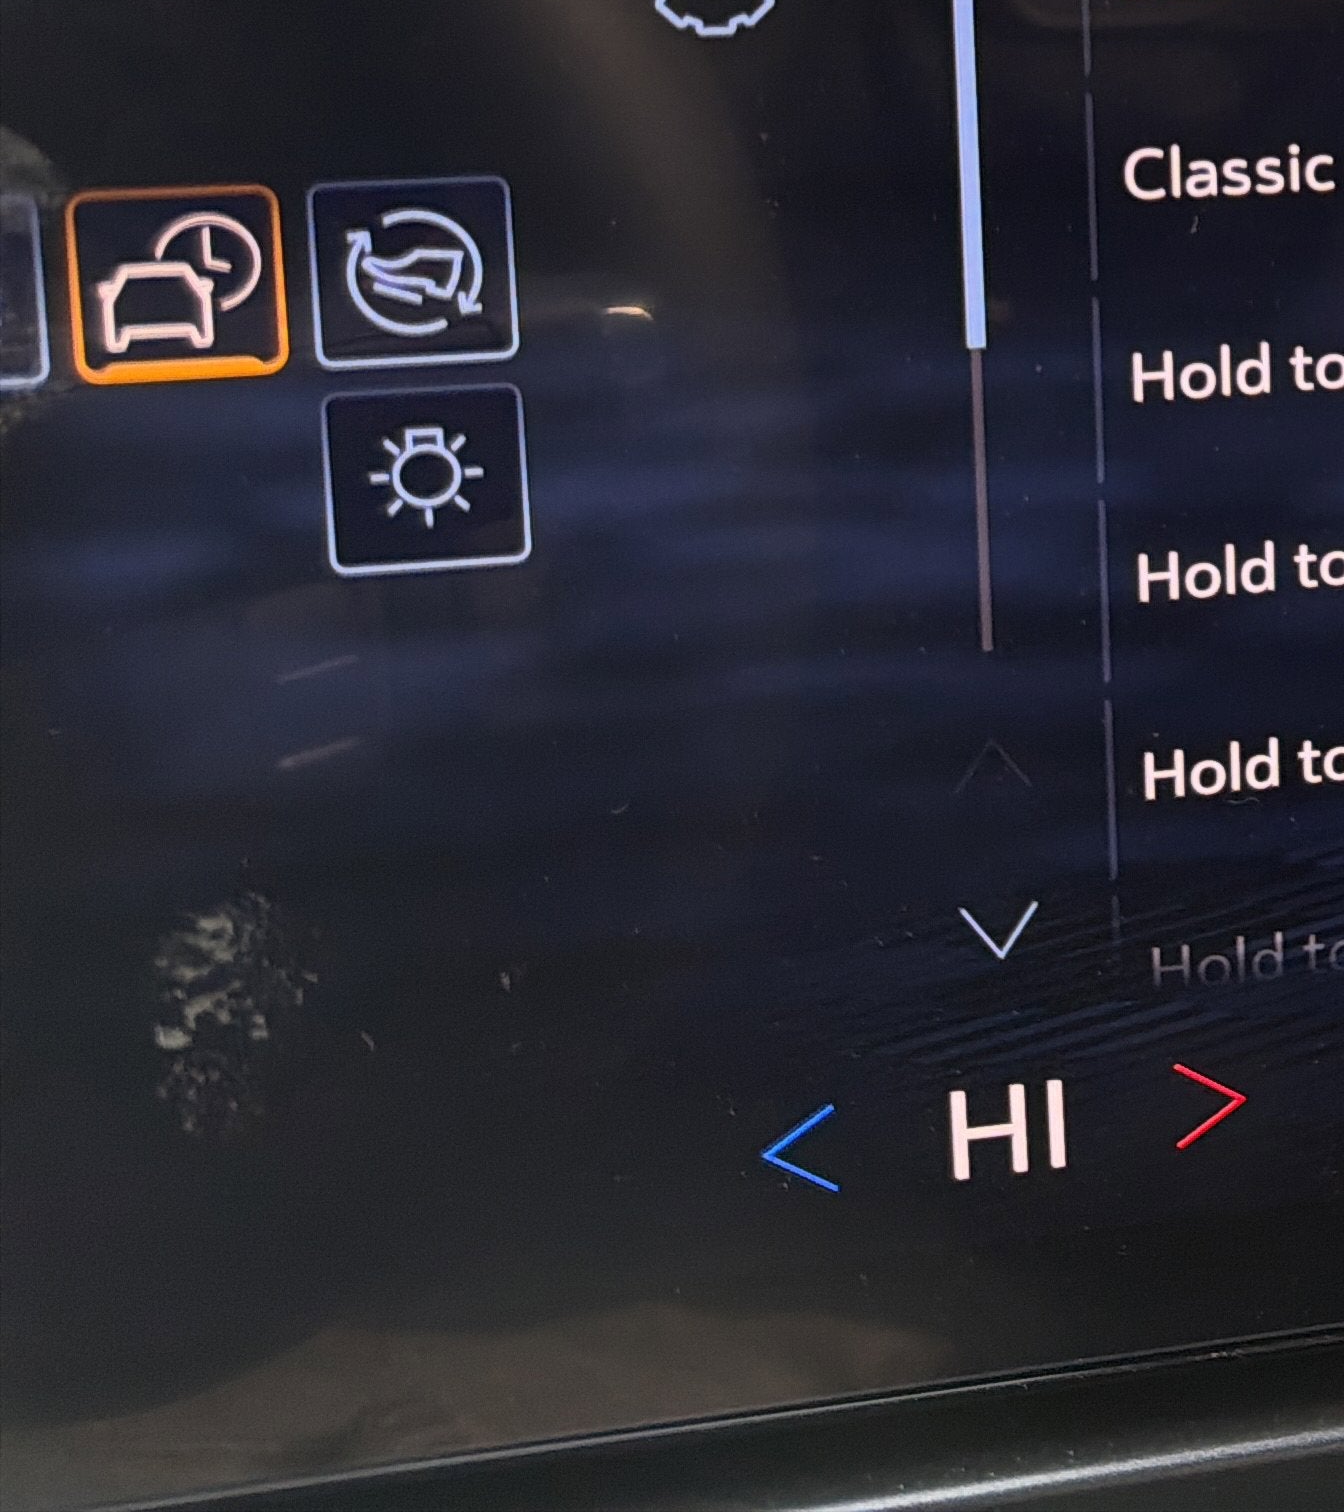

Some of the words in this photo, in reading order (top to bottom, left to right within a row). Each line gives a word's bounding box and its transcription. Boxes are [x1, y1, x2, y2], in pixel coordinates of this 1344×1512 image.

[1124, 143, 1336, 201] Classic
[1132, 341, 1271, 403] Hold
[1137, 539, 1276, 603] Hold
[1143, 736, 1280, 801] Hold
[1151, 931, 1284, 986] Hold
[949, 1079, 1067, 1181] HI
